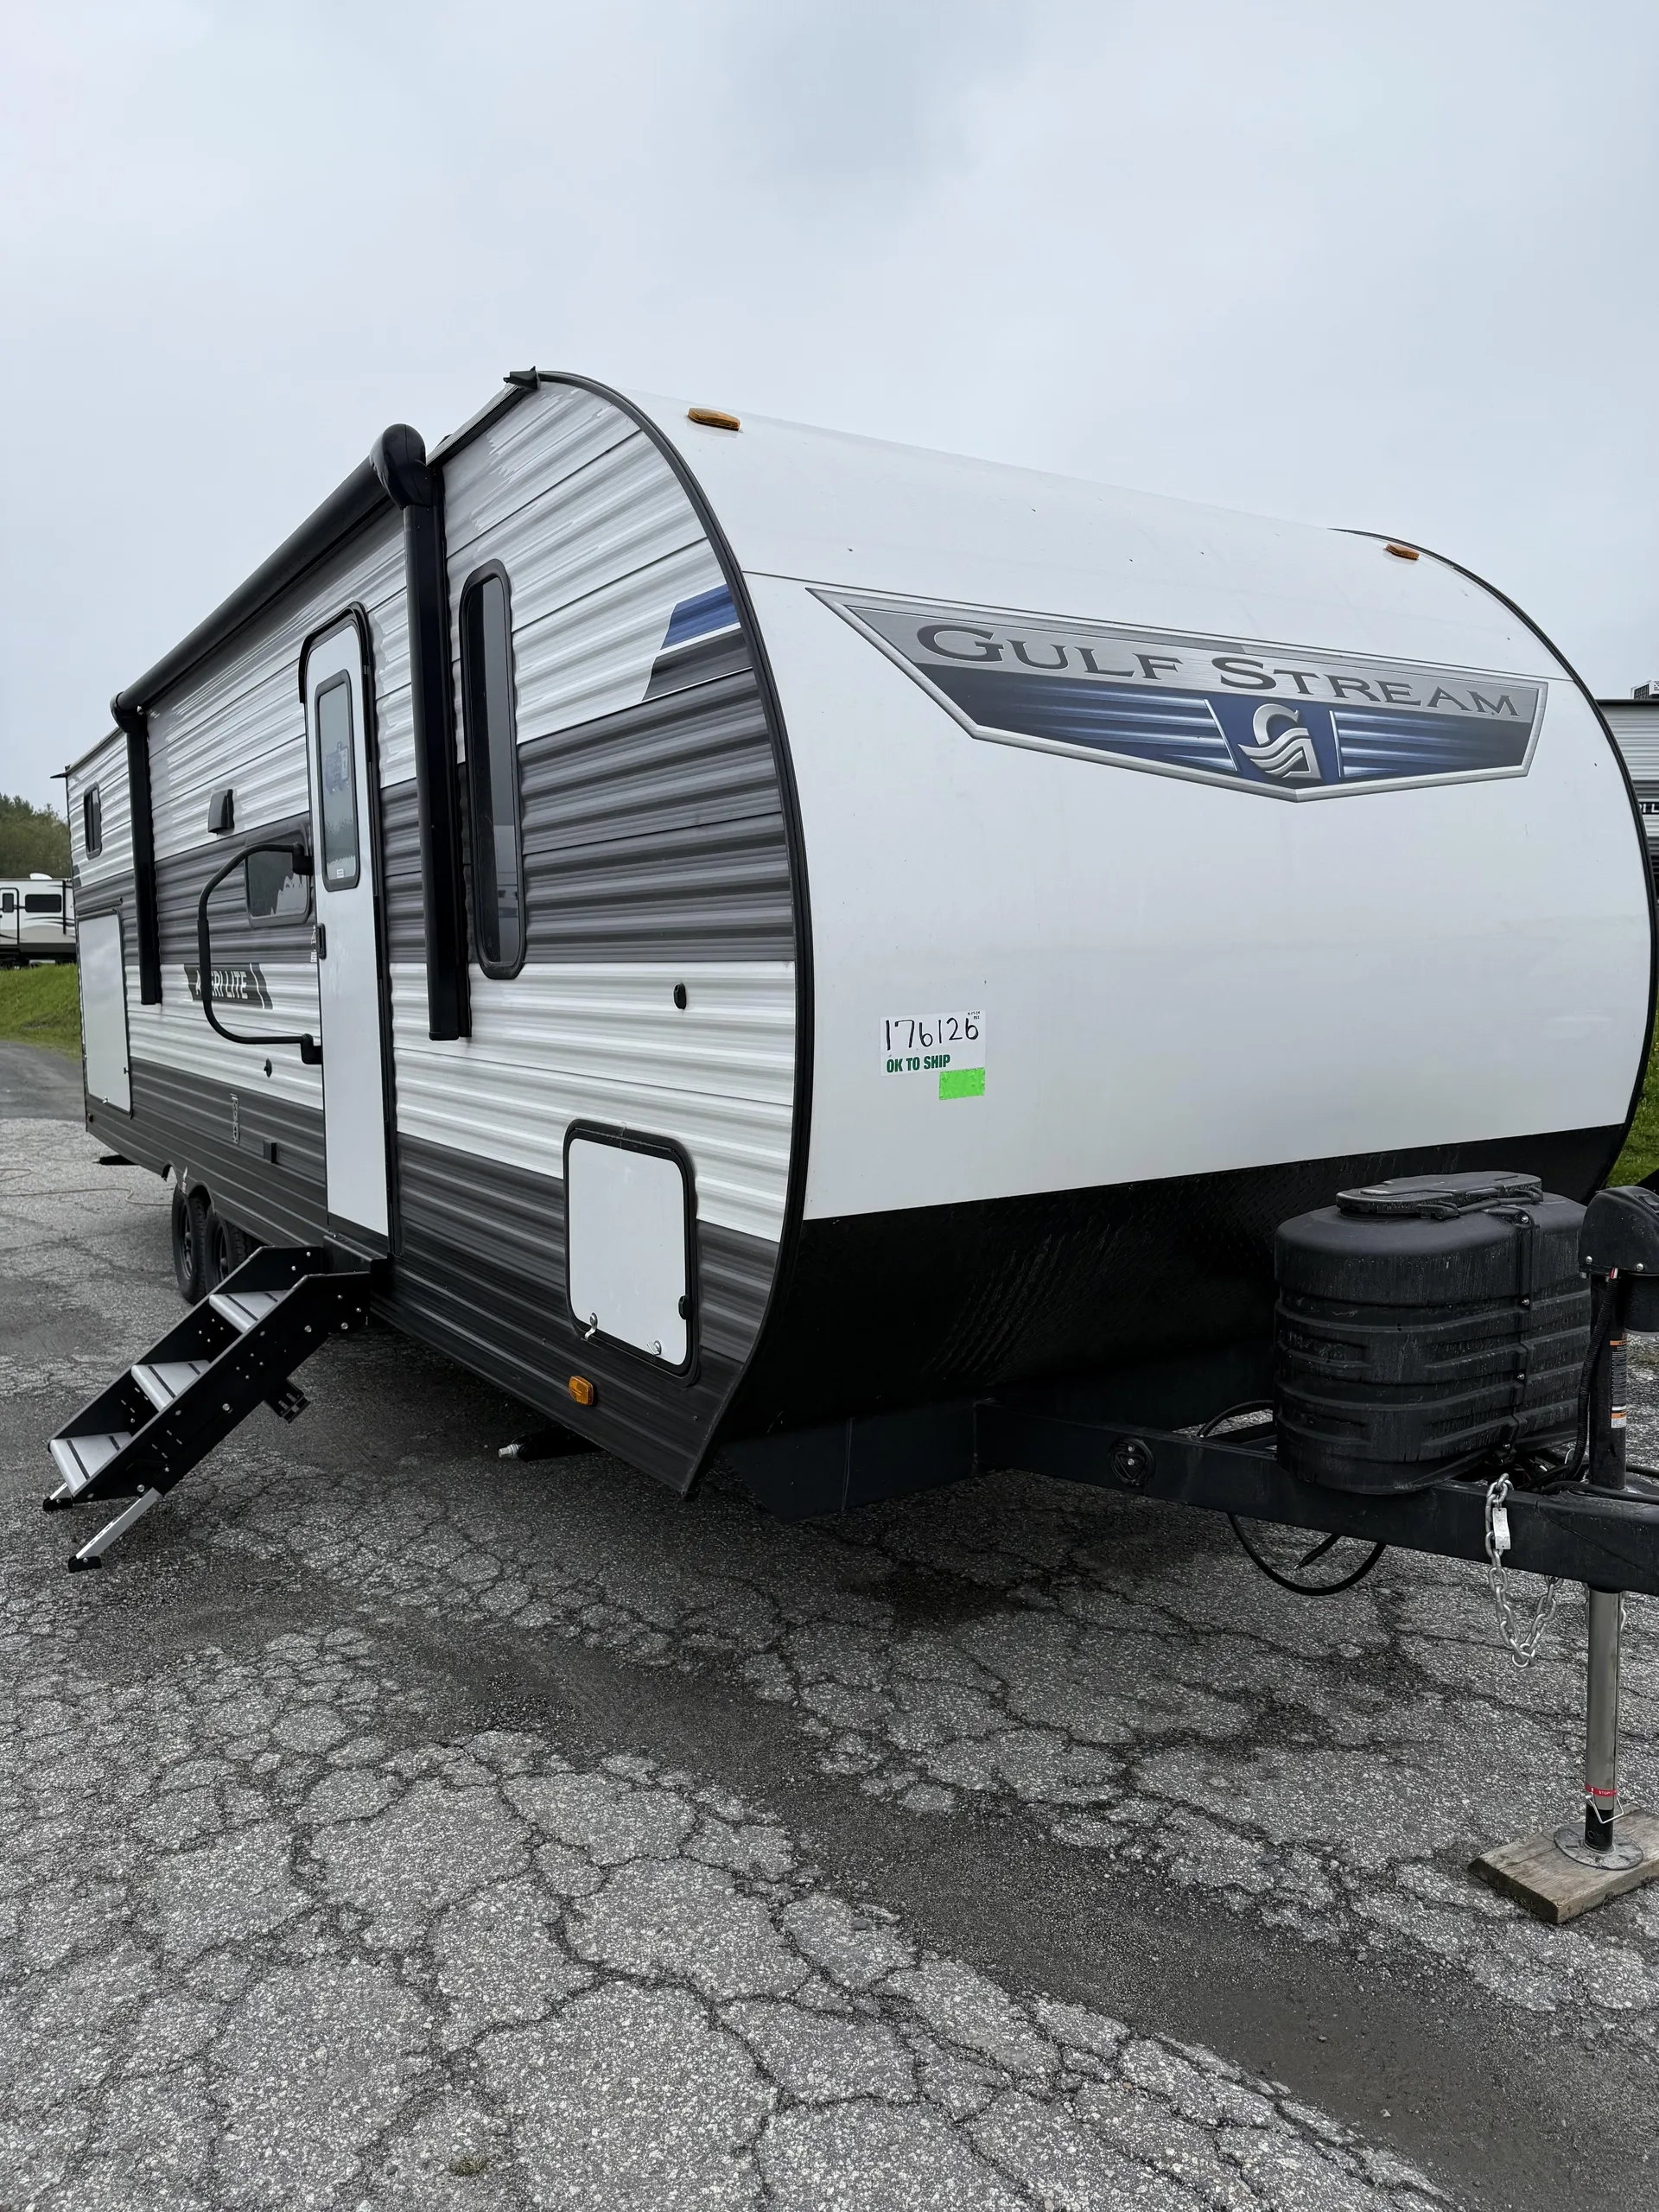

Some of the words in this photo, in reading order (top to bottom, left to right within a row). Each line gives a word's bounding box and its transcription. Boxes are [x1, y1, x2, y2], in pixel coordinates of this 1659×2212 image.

[917, 624, 1184, 680] GULF
[1211, 657, 1521, 717] STREAM
[225, 970, 249, 1000] LITE
[886, 1017, 979, 1051] 176126
[887, 1058, 903, 1073] OK
[906, 1057, 920, 1071] TO
[924, 1054, 950, 1070] SHIP
